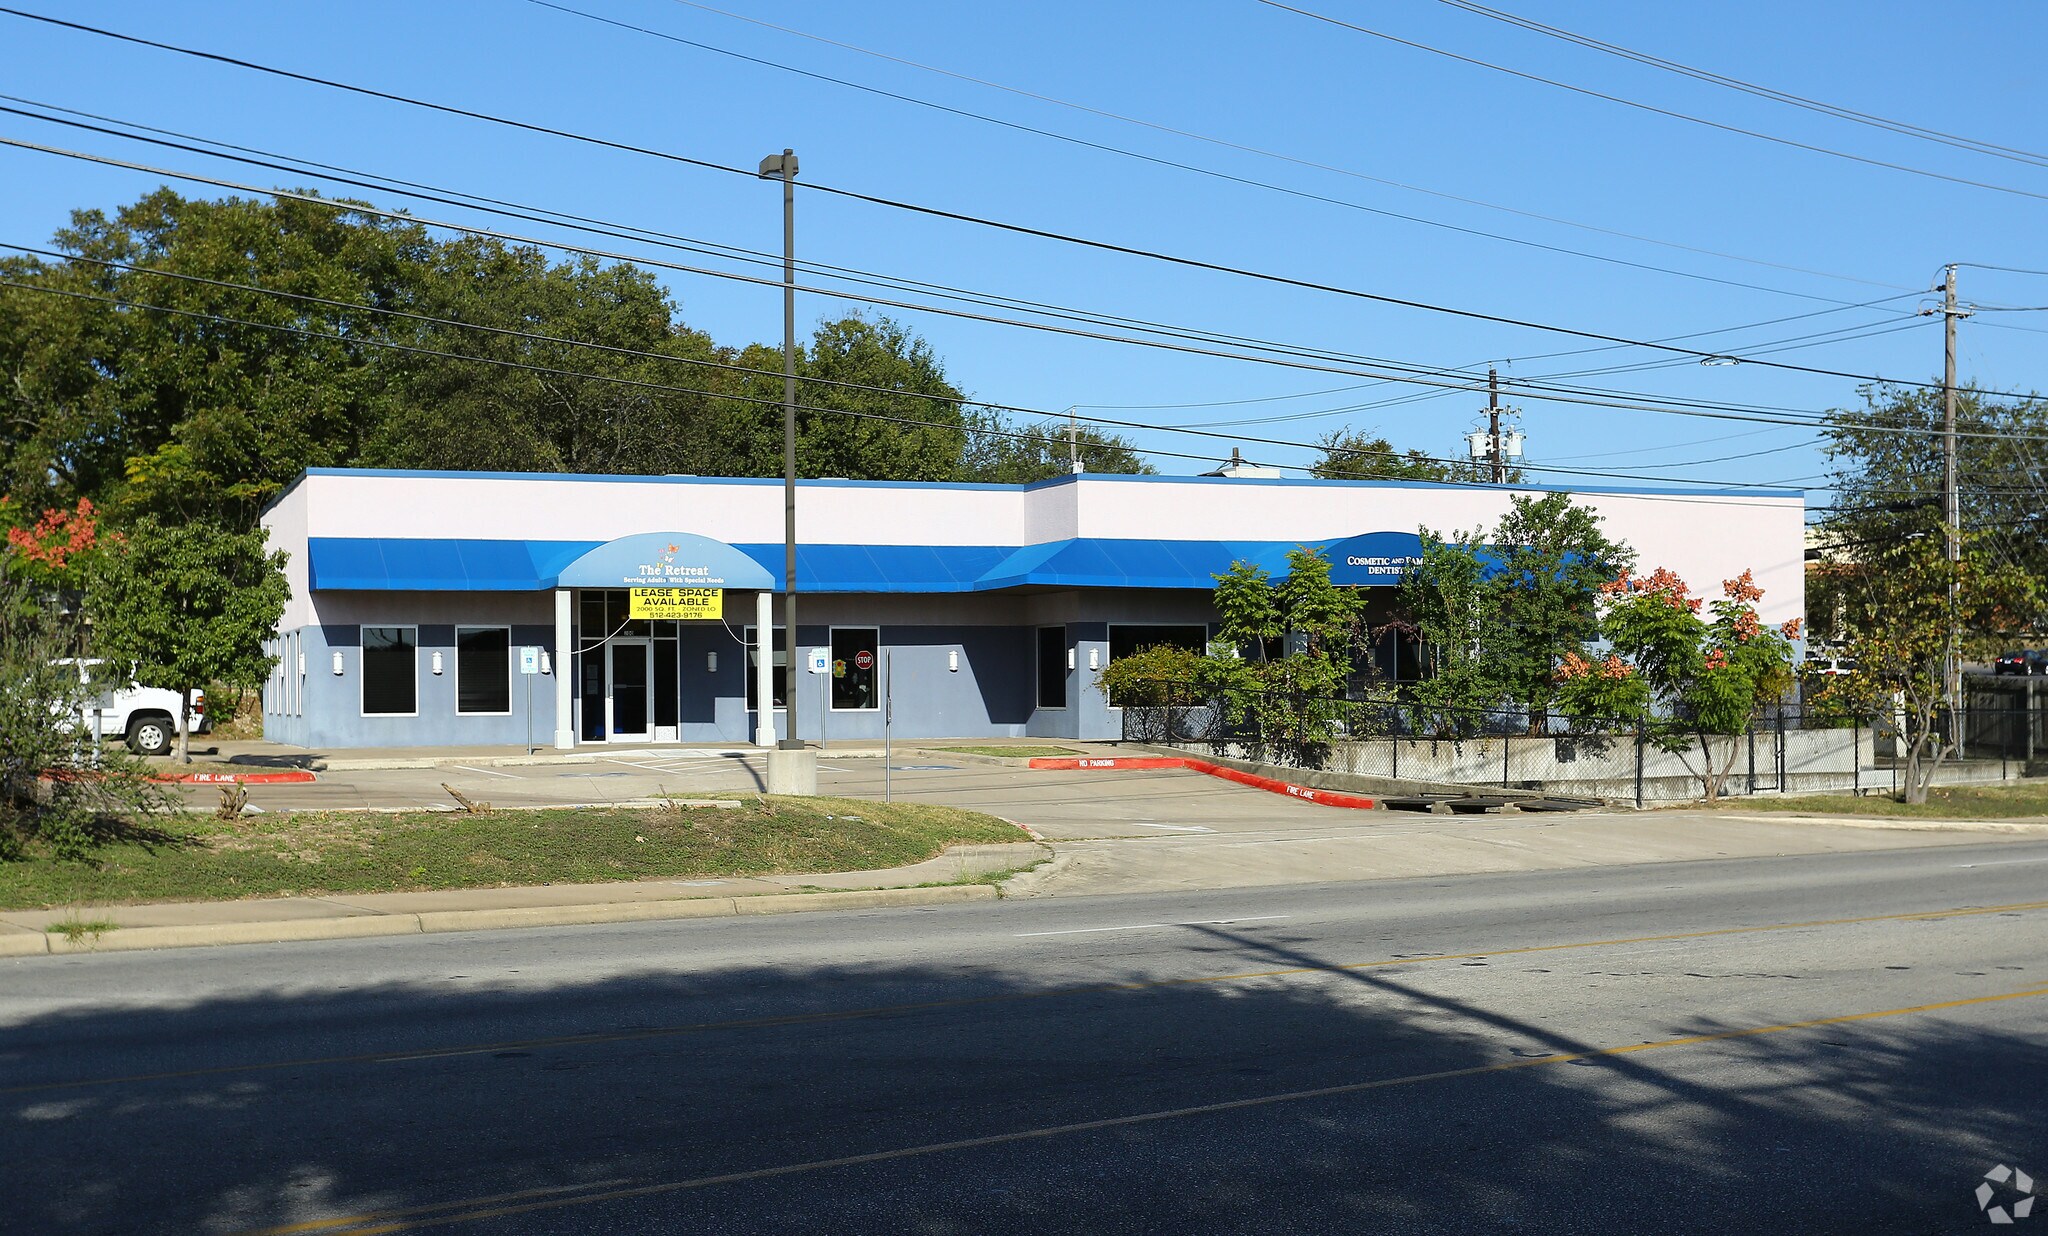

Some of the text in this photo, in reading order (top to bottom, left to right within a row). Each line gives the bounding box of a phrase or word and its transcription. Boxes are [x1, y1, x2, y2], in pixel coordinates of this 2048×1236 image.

[1347, 556, 1390, 566] COSMETIC
[638, 564, 708, 576] The Retreat
[194, 773, 235, 782] FIRE LANE
[1286, 785, 1314, 800] FIRE LANE
